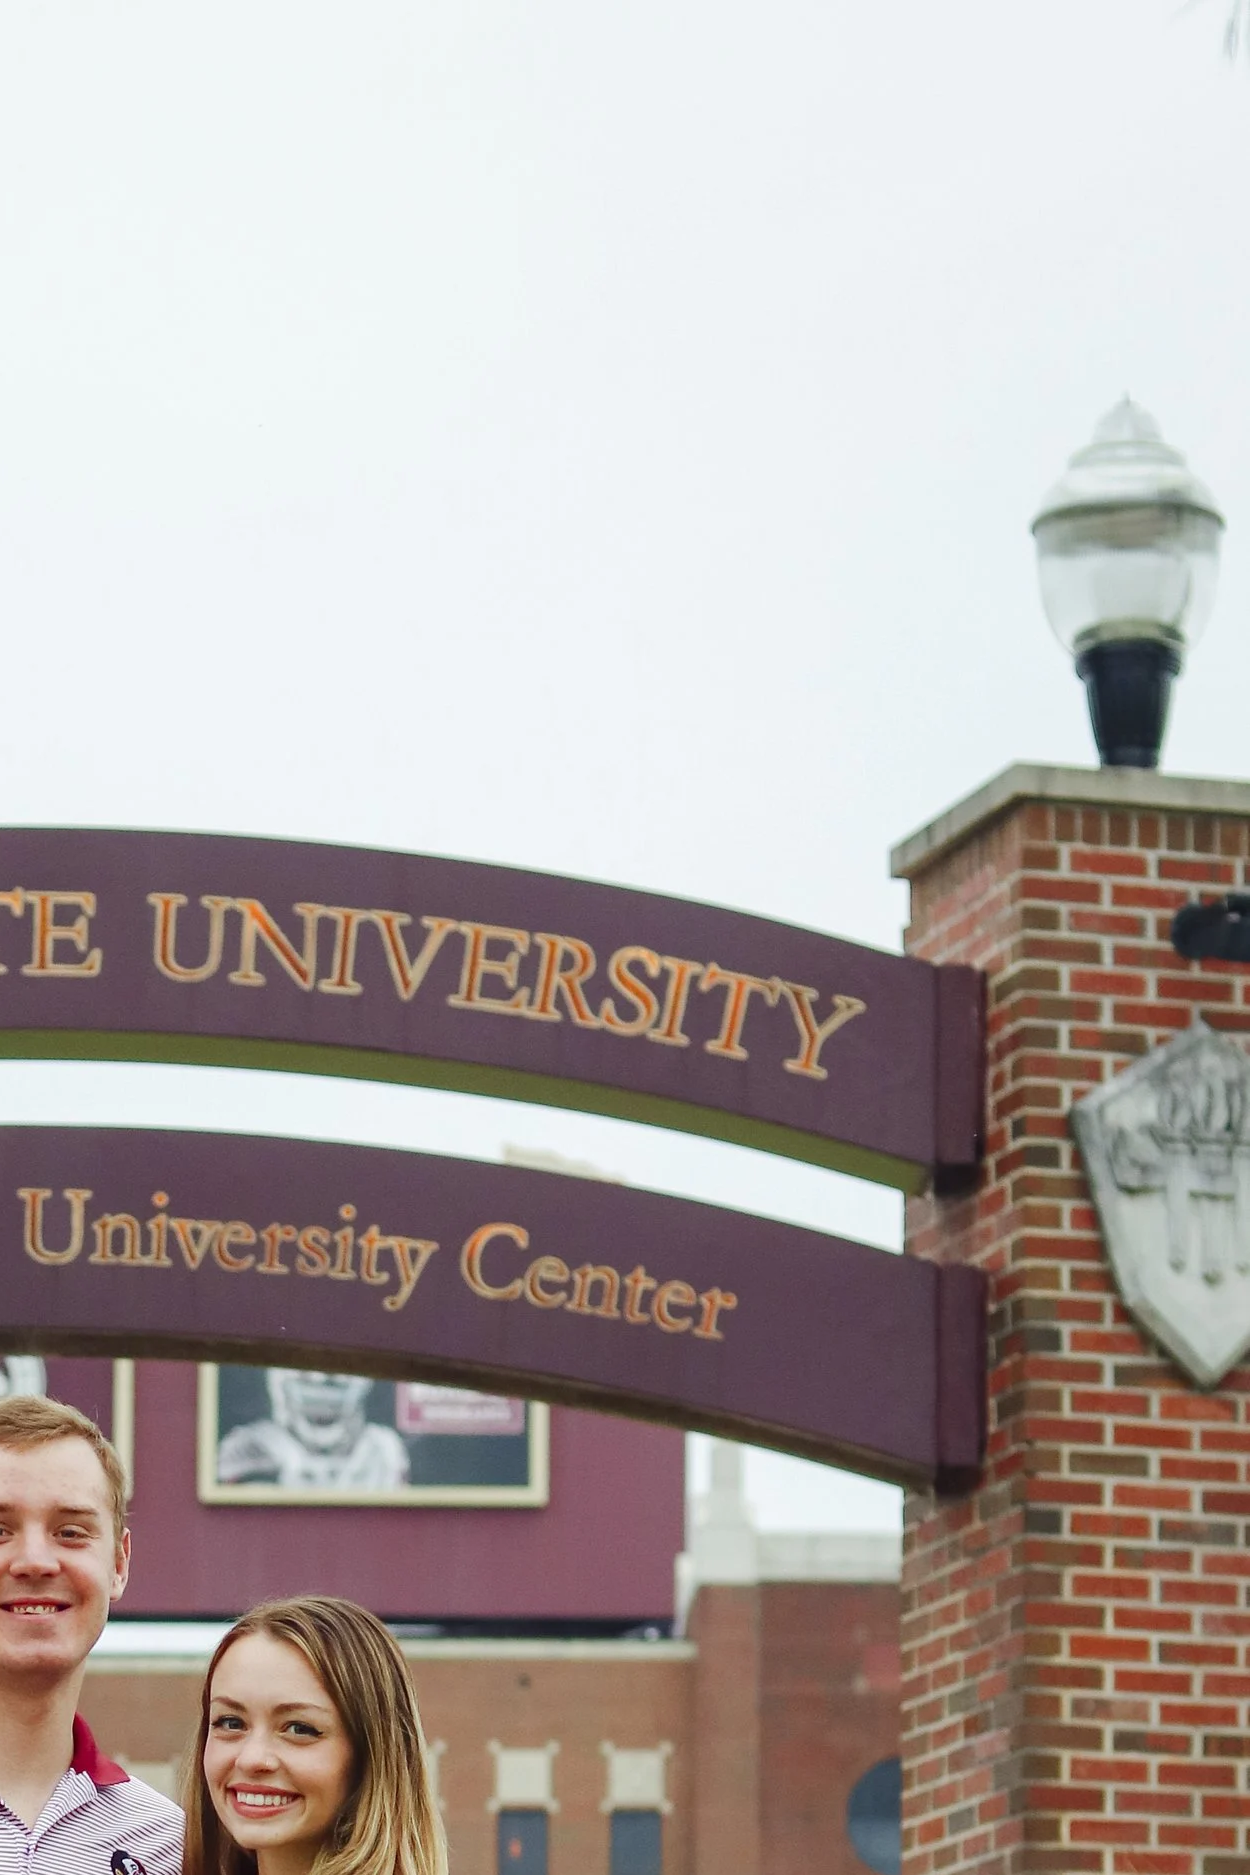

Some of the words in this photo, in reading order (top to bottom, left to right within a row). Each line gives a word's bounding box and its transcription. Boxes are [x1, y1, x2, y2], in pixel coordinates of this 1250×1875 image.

[149, 894, 865, 1080] UNIVERSITY
[17, 1187, 439, 1312] University
[460, 1223, 738, 1341] Center
